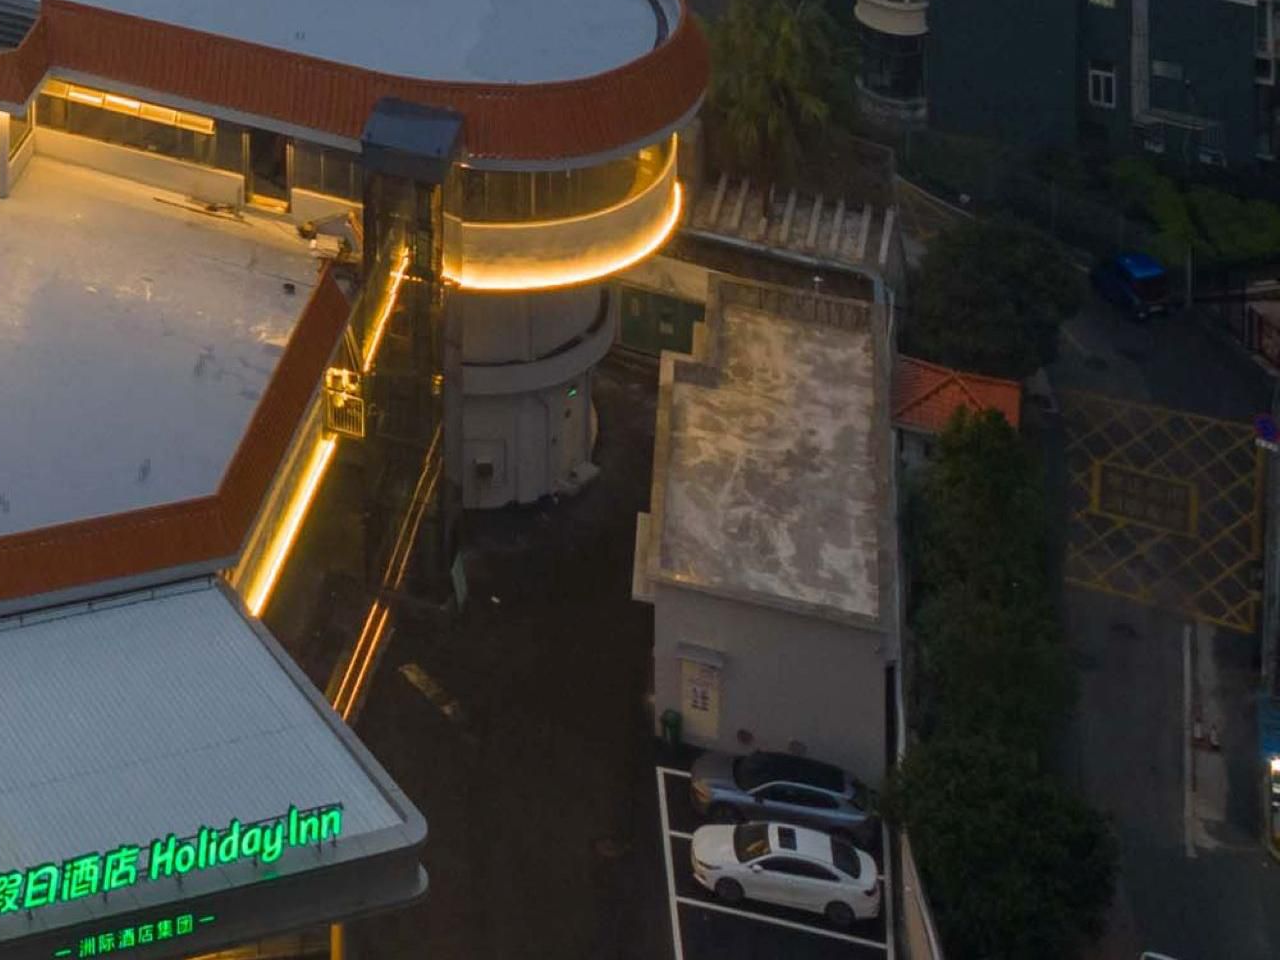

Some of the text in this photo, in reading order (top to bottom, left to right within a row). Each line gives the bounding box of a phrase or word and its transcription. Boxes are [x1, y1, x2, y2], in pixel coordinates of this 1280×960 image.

[151, 820, 287, 879] Holiday
[289, 807, 344, 847] Inn
[78, 914, 193, 958] 洲际酒店集团
